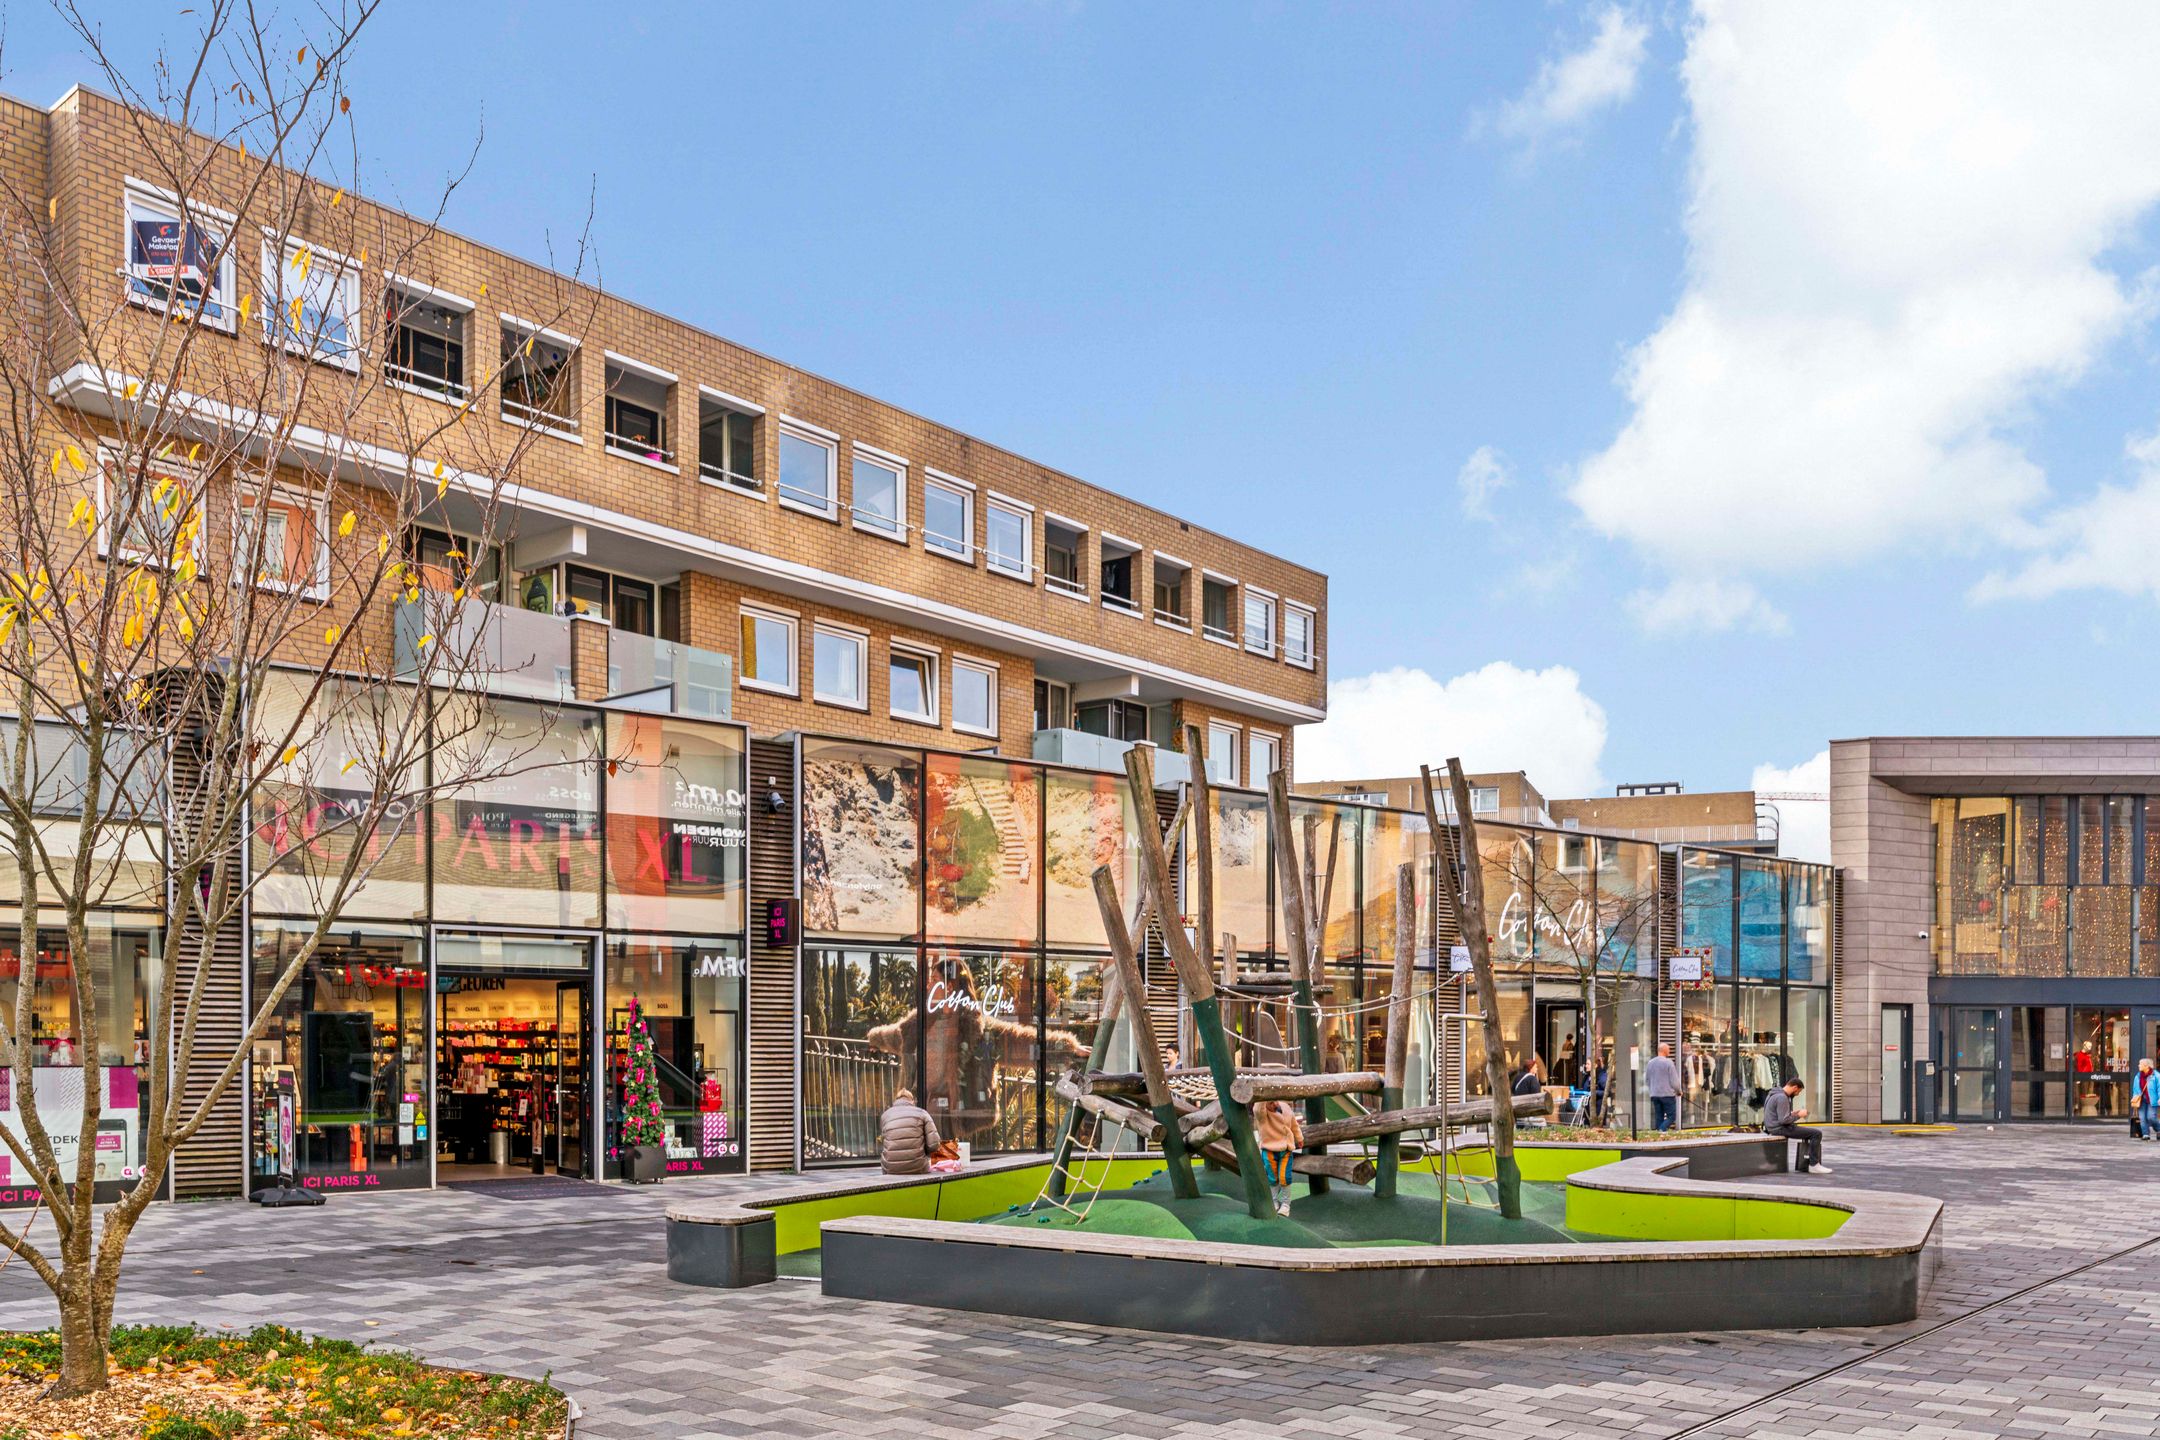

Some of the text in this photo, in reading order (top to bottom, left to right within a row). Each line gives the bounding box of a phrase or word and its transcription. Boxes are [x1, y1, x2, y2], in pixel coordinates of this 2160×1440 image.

[635, 828, 708, 883] XL
[773, 907, 782, 917] ICI
[770, 917, 786, 928] PARIS
[774, 929, 782, 939] XL
[926, 981, 1015, 1018] Cotton Club
[665, 1160, 705, 1172] ARIS XL
[303, 1174, 380, 1188] ICI PARIS XL
